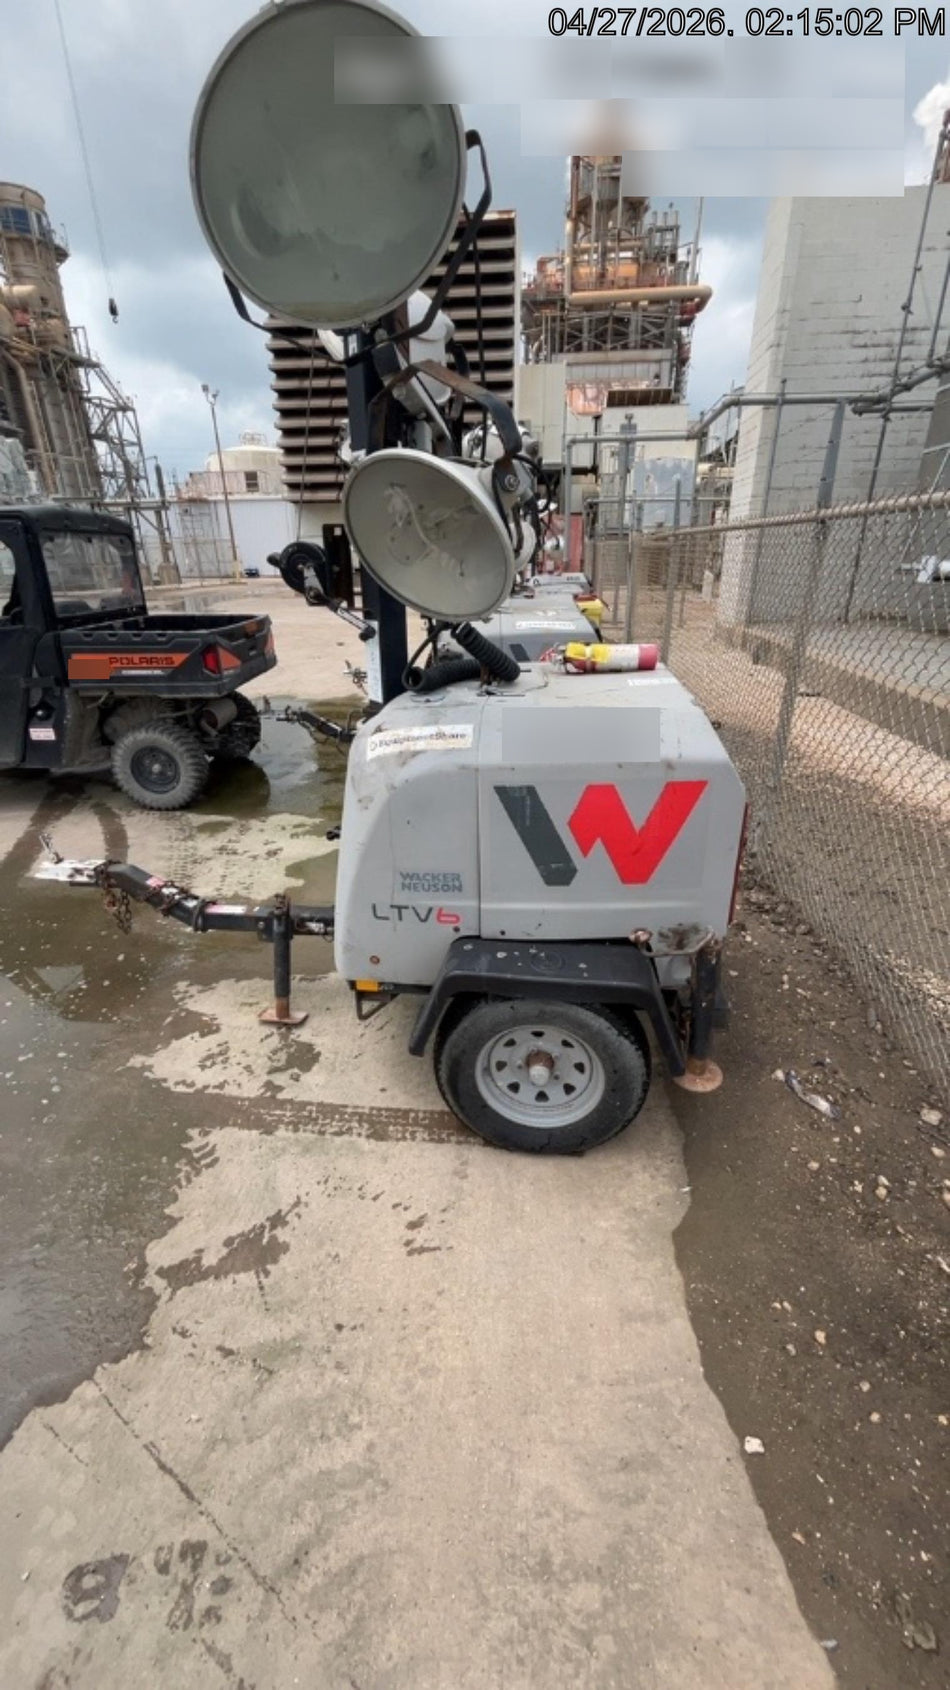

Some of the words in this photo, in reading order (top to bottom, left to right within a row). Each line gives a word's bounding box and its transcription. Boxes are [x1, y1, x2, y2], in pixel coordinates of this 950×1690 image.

[108, 656, 176, 666] POLARIS
[400, 872, 461, 882] WACKER
[401, 882, 463, 893] NEUSON
[371, 903, 461, 925] LTV6
